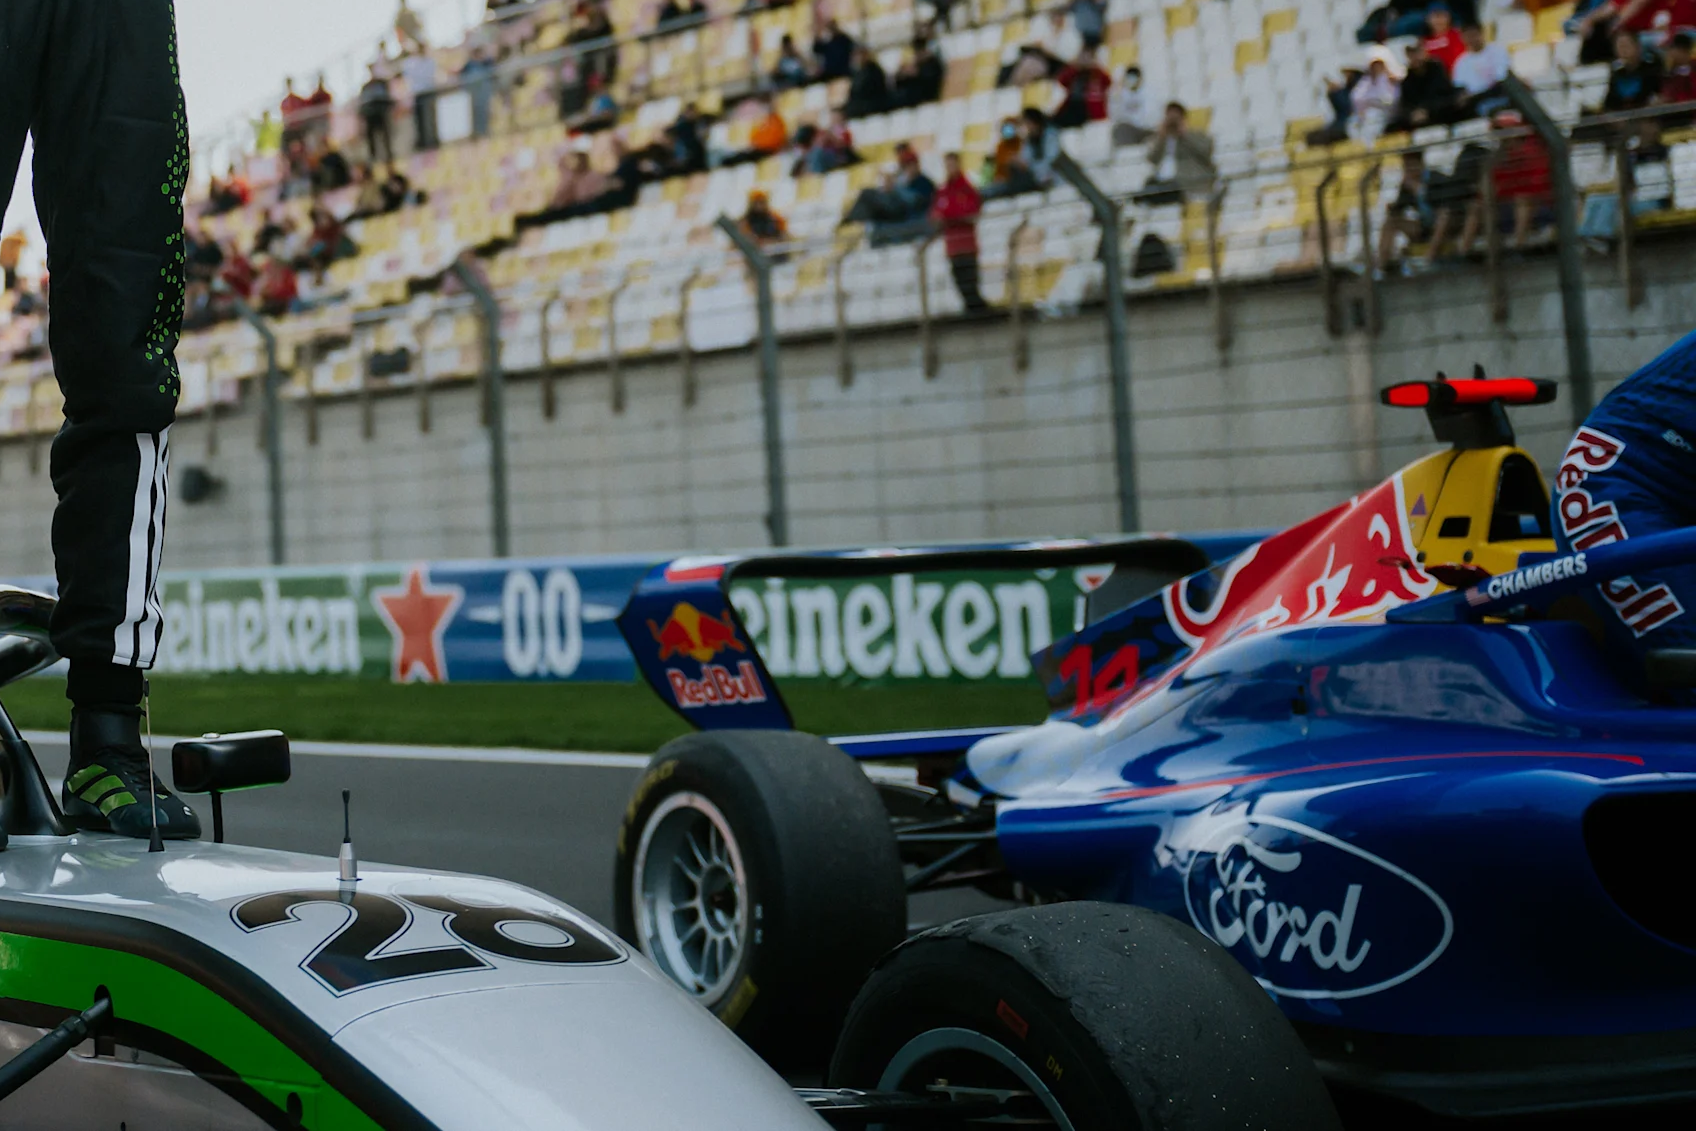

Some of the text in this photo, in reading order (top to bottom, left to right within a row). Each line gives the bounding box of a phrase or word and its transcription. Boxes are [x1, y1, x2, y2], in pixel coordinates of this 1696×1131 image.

[1556, 426, 1627, 538] Red
[163, 571, 362, 673] eineken
[729, 572, 1053, 680] eineken
[1487, 552, 1588, 600] CHAMBERS
[665, 659, 767, 709] Red Bull
[1059, 644, 1141, 717] 14
[229, 883, 630, 998] 28
[1208, 835, 1372, 974] Ford
